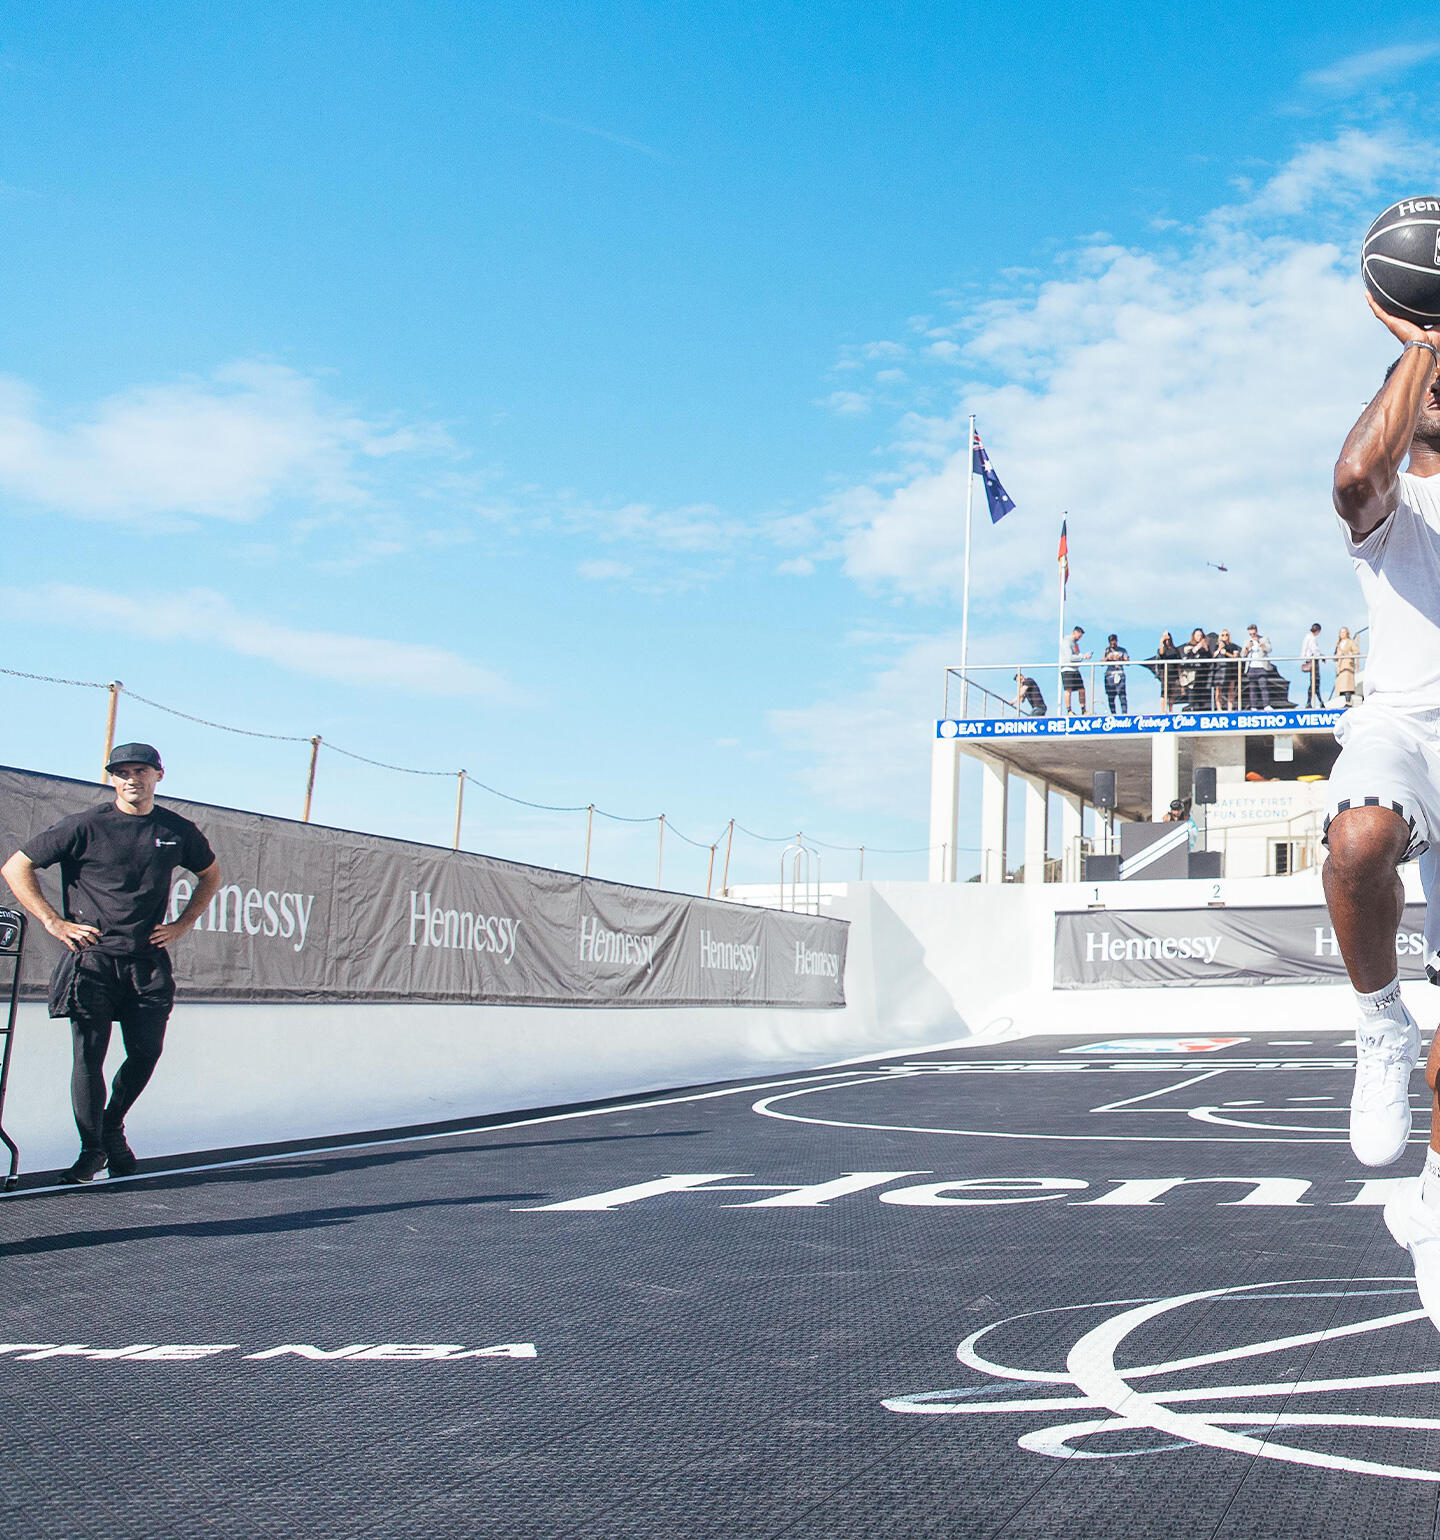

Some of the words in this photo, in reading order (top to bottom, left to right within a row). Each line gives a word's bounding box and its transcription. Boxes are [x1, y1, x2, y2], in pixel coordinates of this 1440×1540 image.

[958, 722, 985, 735] EAT
[994, 719, 1039, 733] DRINK
[1047, 717, 1092, 732] RELAX
[1200, 716, 1229, 729] BAR
[1237, 714, 1286, 728] BISTRO
[1295, 712, 1341, 726] VIEWS
[1093, 887, 1099, 901] 1
[1212, 884, 1221, 898] 2
[409, 890, 521, 965] Hennessy
[579, 915, 658, 974] Hennessy
[700, 929, 760, 980] Hennessy
[1085, 931, 1222, 964] Hennessy
[795, 940, 841, 984] Hennessy
[242, 1343, 538, 1360] NBA
